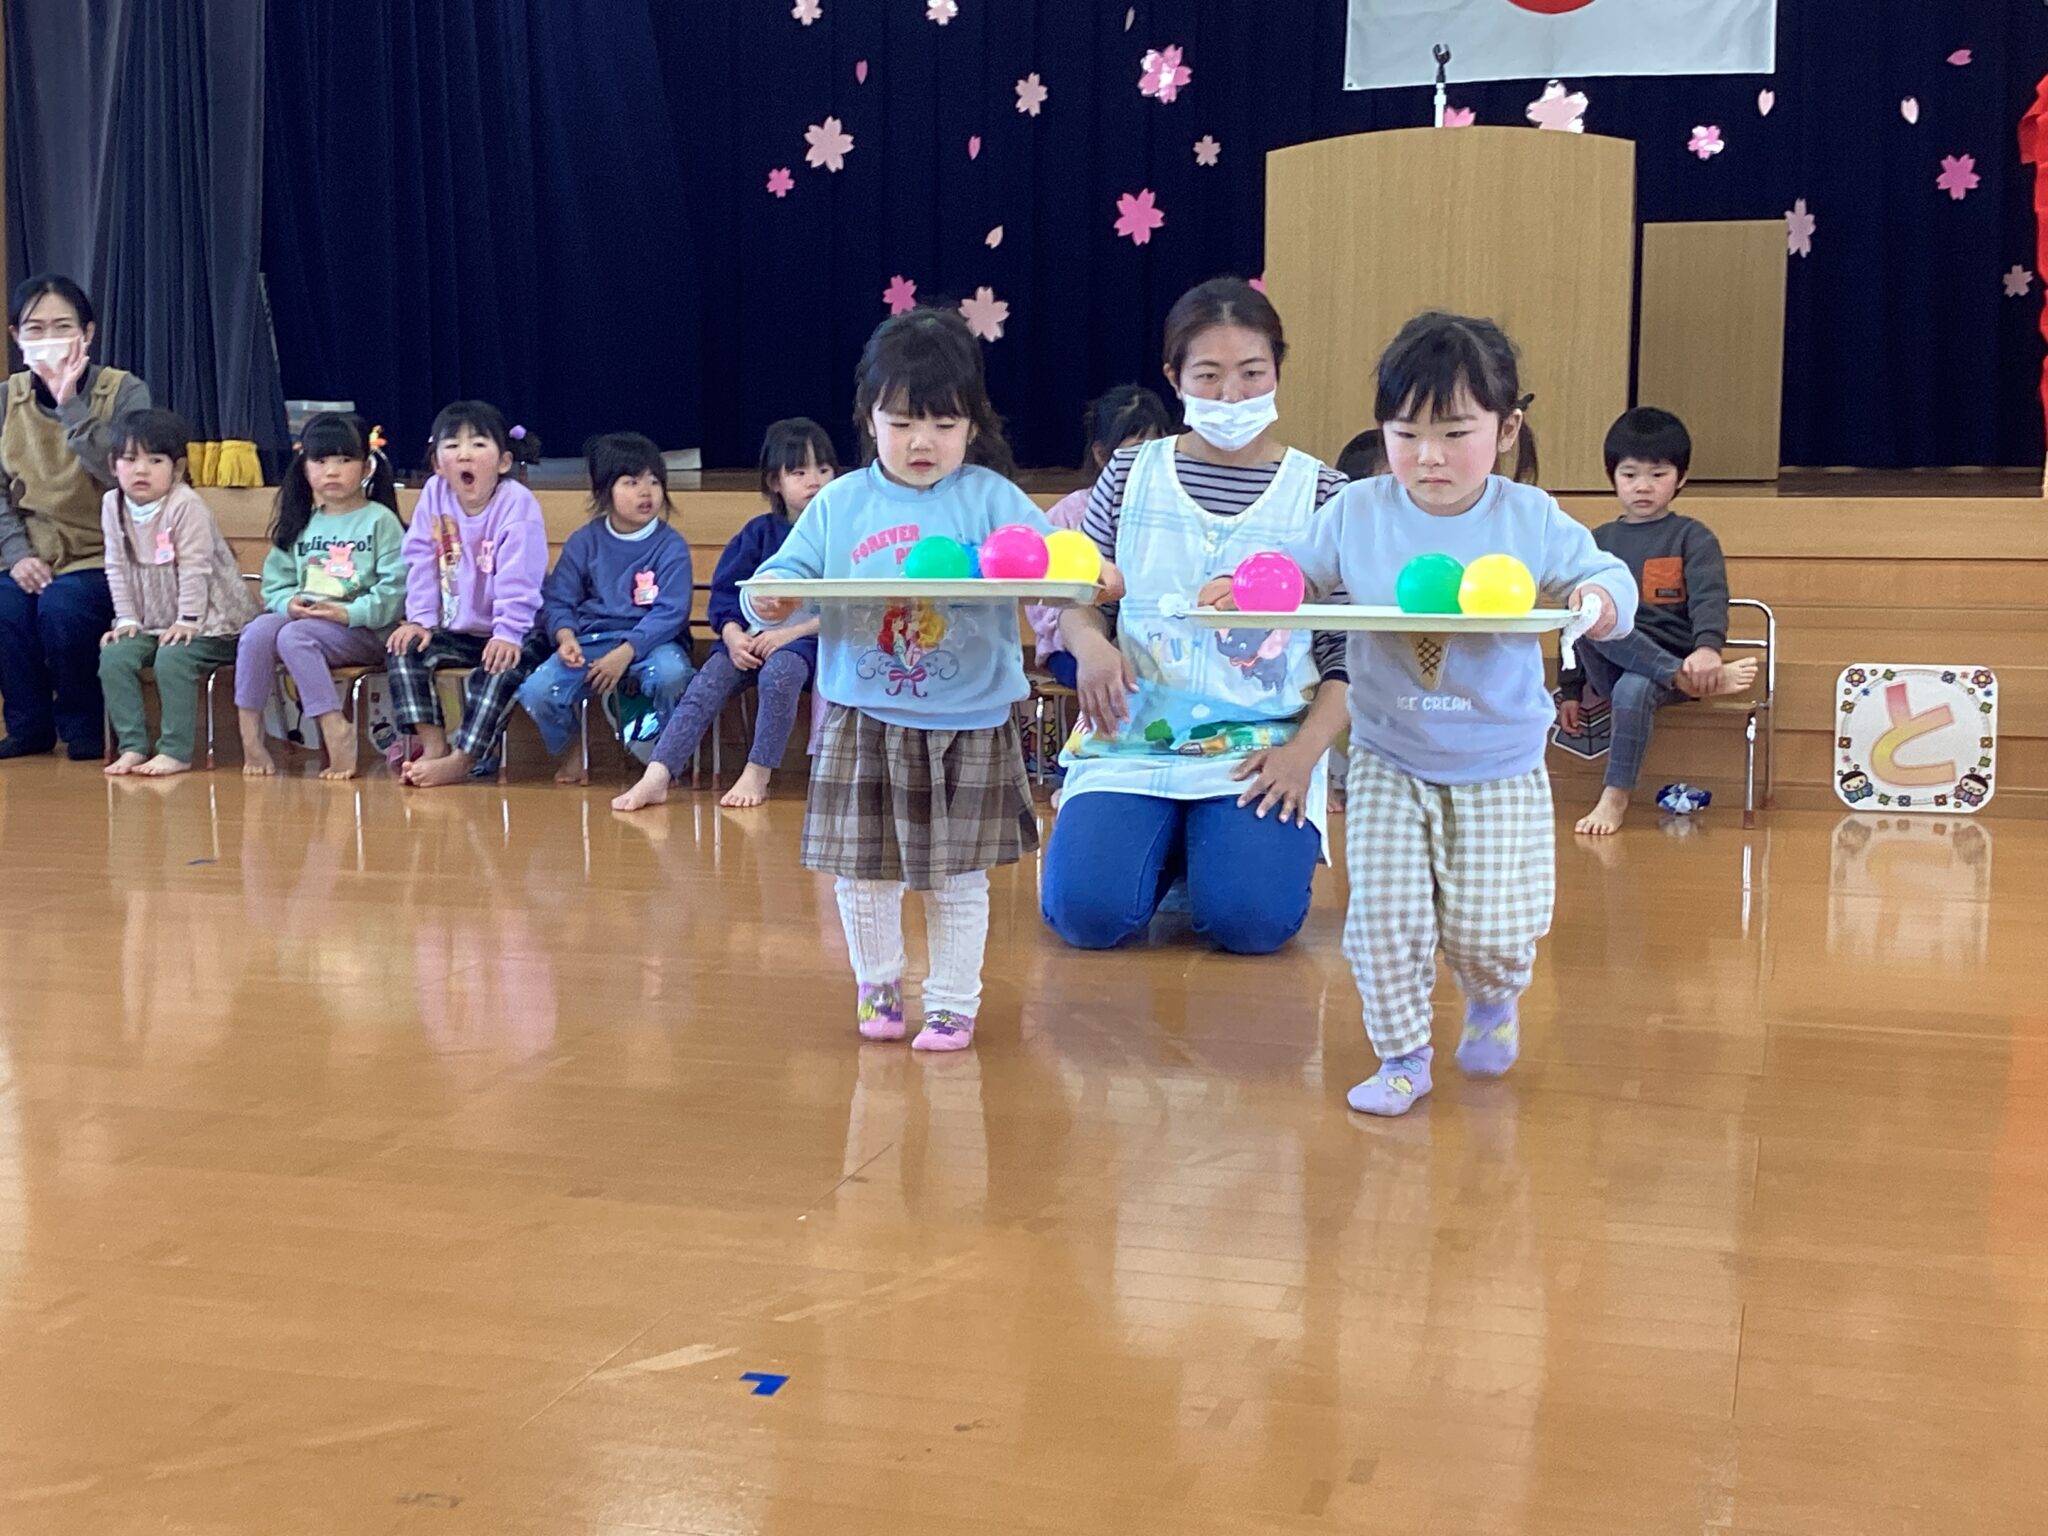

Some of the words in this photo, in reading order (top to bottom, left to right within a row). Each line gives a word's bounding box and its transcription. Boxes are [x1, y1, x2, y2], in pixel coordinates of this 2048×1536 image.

[852, 524, 919, 565] FOREVER
[1396, 695, 1418, 711] ICE
[1422, 695, 1472, 711] CREAM
[1871, 681, 1955, 787] と
